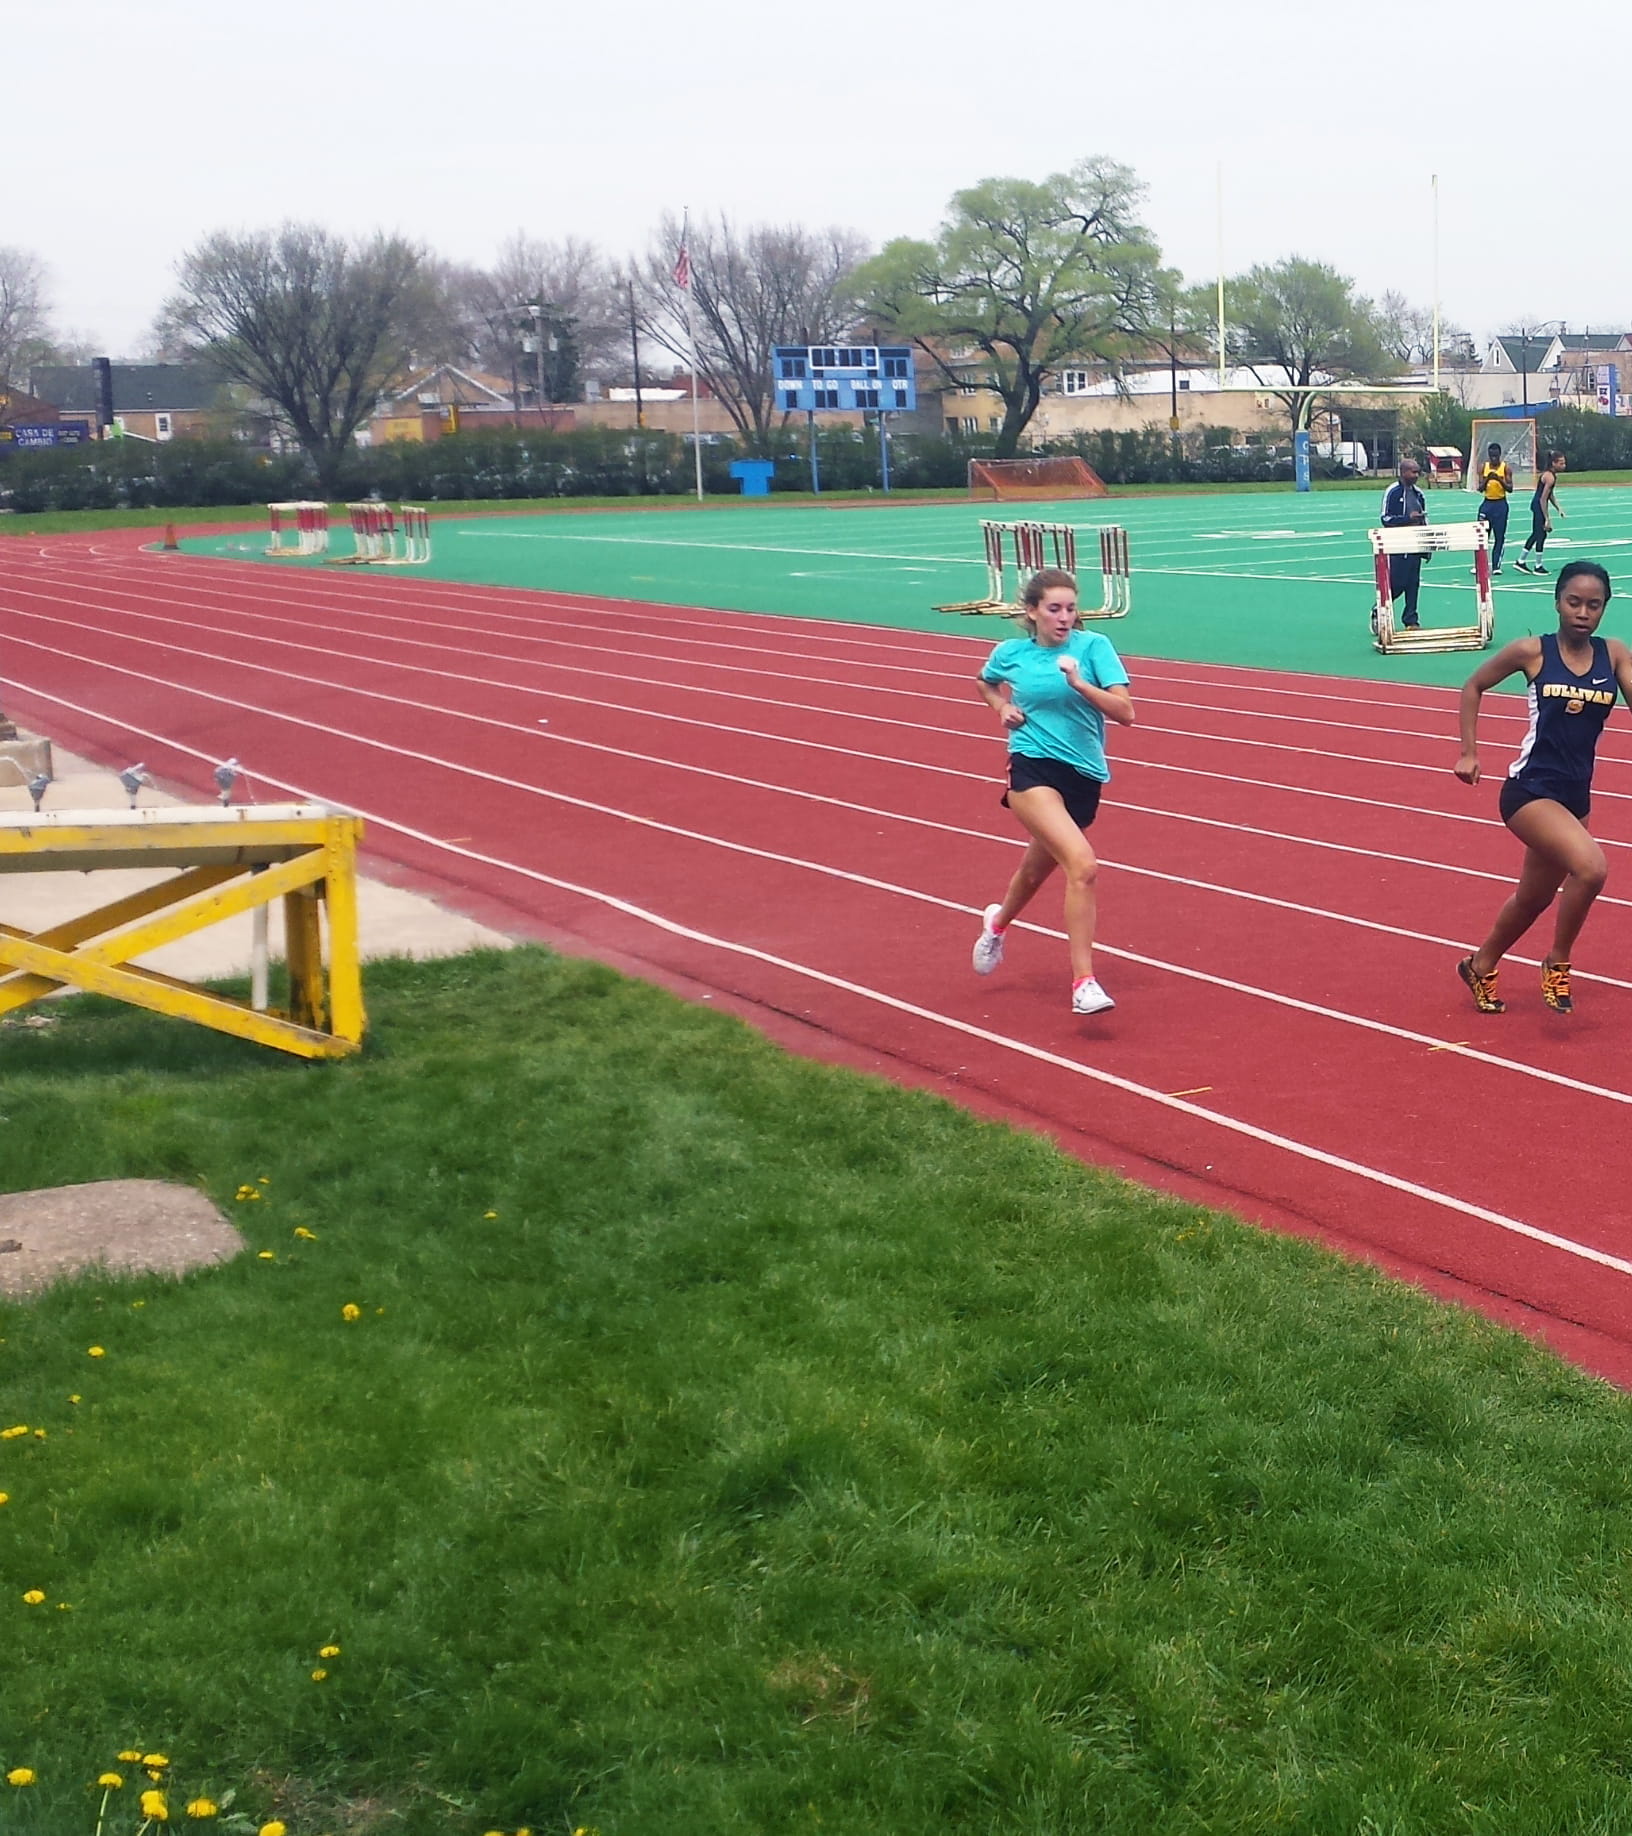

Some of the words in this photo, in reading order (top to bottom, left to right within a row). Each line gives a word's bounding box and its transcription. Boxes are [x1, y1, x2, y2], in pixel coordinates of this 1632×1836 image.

[15, 428, 39, 438] CASA
[42, 428, 54, 438] DE
[17, 437, 53, 446] CAMBIO
[1542, 683, 1614, 706] SULLIVAN
